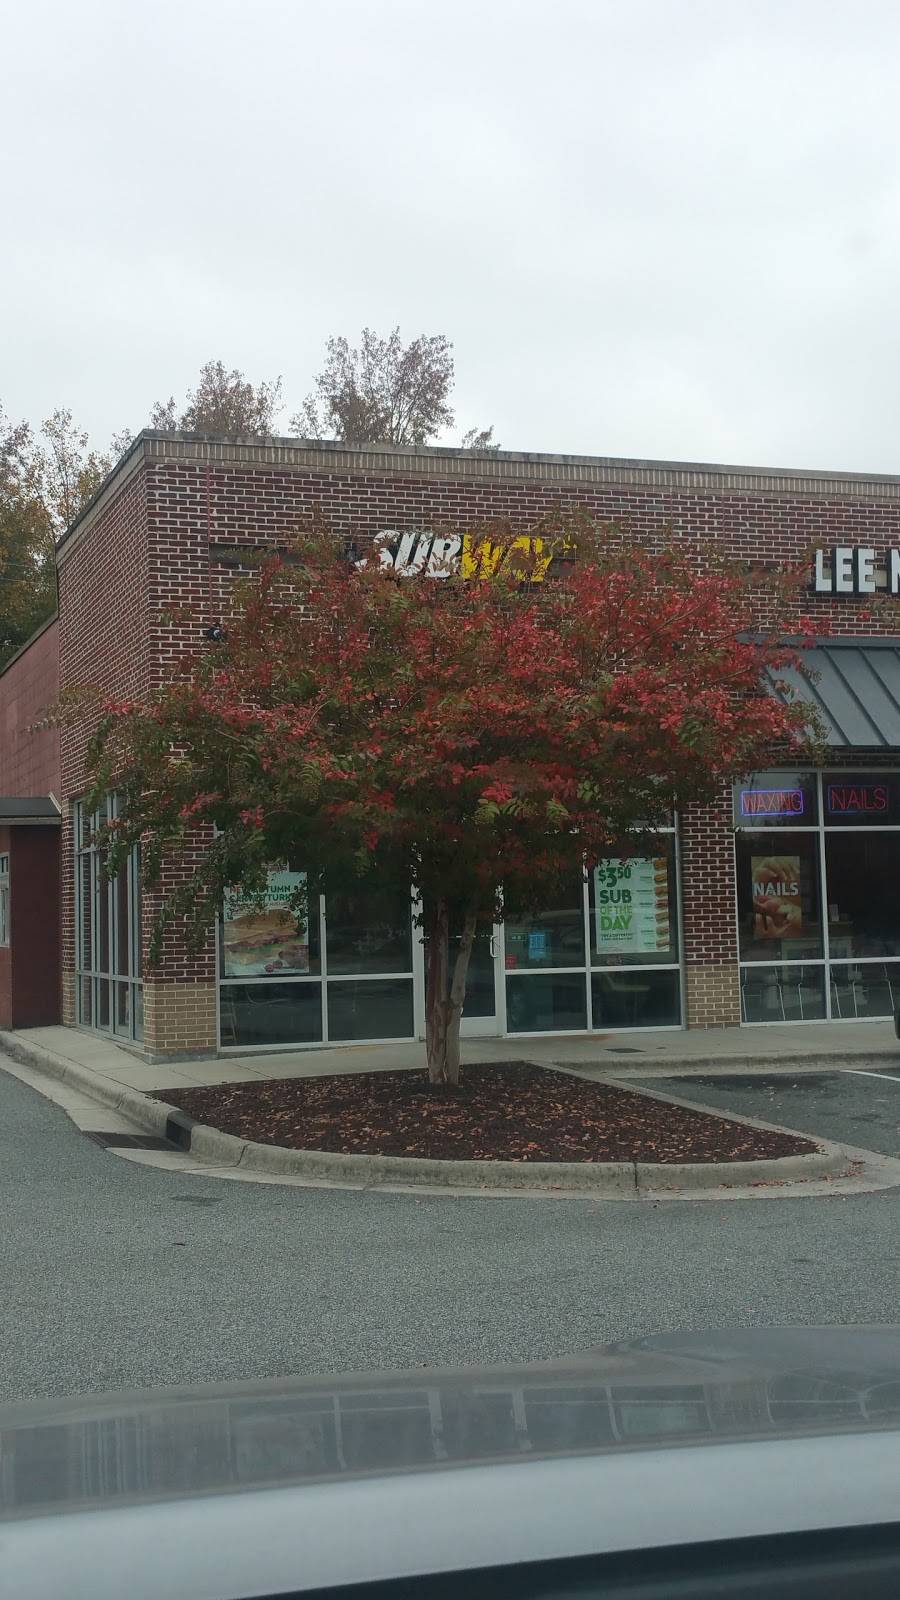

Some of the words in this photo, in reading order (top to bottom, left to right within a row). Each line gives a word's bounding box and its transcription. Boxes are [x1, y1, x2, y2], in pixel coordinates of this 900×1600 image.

[815, 547, 876, 593] LEE
[743, 792, 802, 813] WAXING
[831, 788, 886, 811] NAILS
[600, 889, 632, 904] SUB
[753, 882, 799, 896] NAILS
[600, 905, 613, 915] OF
[614, 905, 632, 914] THE
[601, 915, 632, 931] DAY
